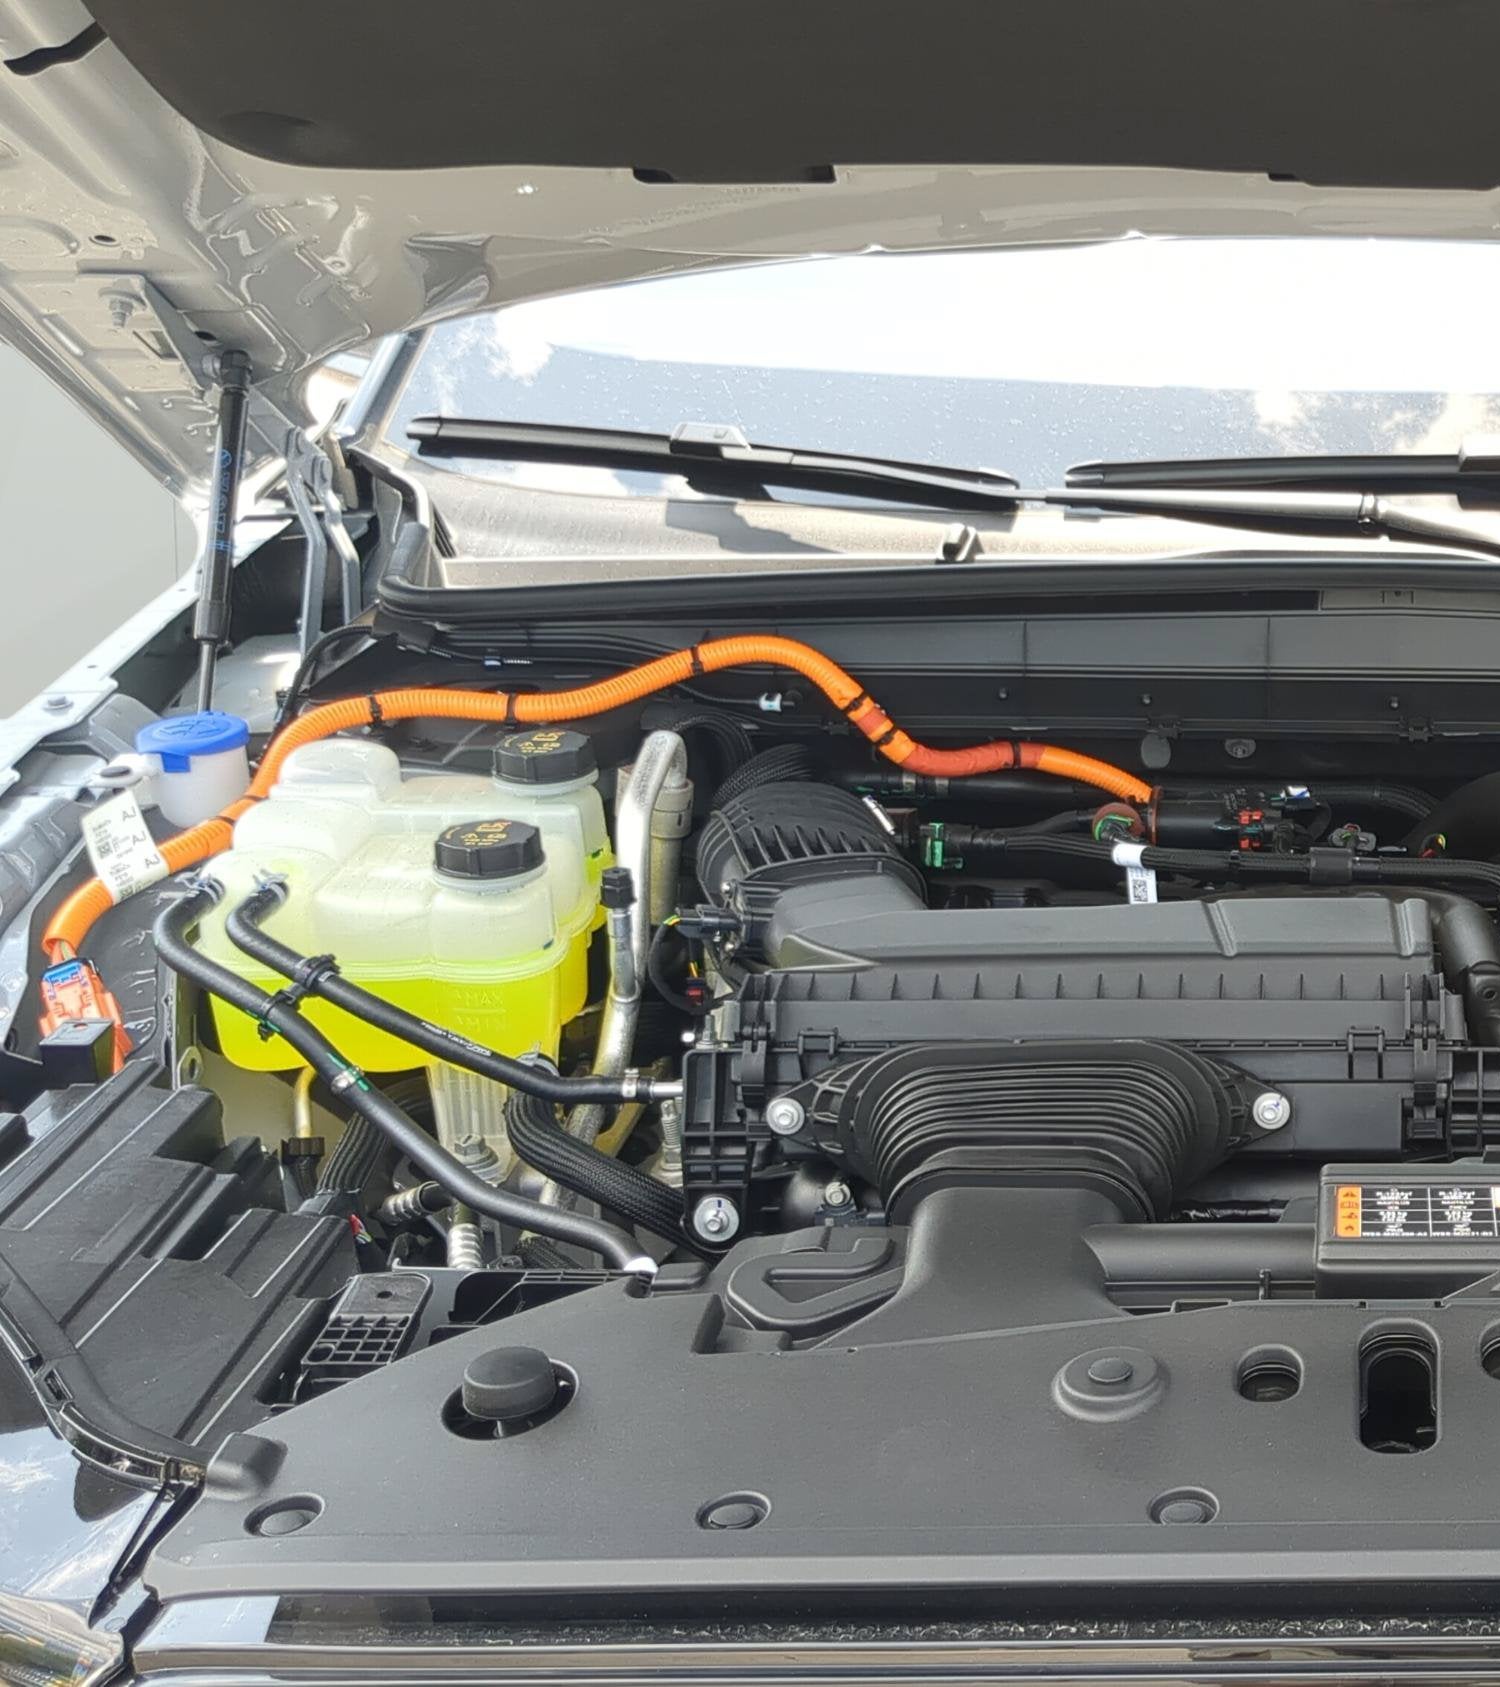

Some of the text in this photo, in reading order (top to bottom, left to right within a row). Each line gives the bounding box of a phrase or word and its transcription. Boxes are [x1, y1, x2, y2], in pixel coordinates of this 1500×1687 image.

[122, 806, 137, 821] AJ
[133, 830, 147, 845] AJ
[145, 854, 160, 869] AJ
